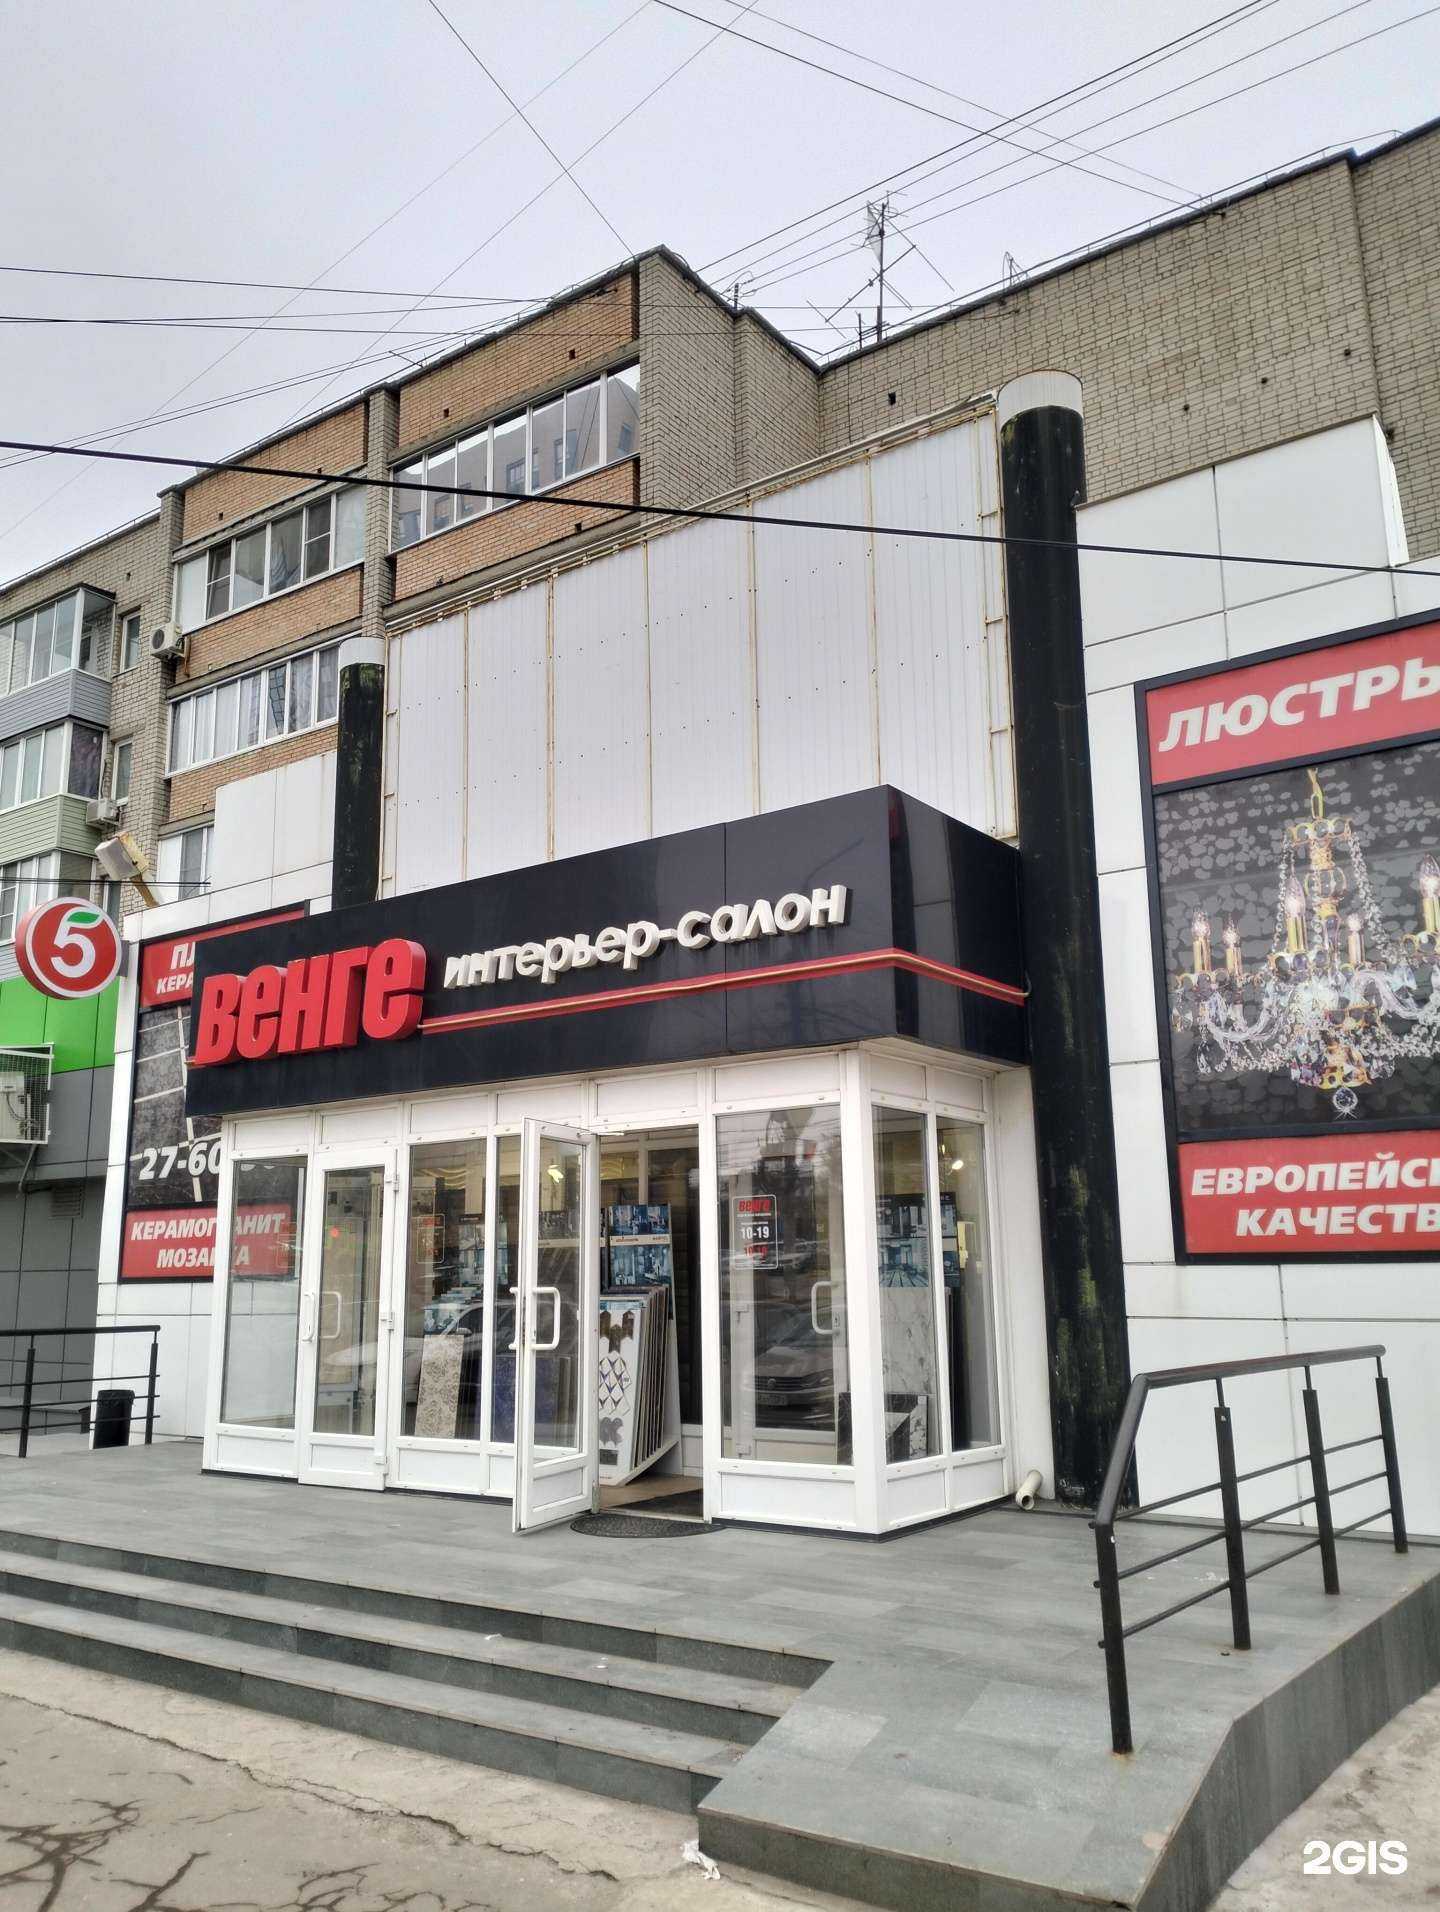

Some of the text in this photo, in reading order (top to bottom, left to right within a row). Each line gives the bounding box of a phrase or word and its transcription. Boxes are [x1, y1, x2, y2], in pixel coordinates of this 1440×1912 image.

[51, 908, 102, 978] 5
[444, 884, 848, 989] интерьер-салон
[130, 1213, 286, 1241] КЕРАМОГАНИТ
[741, 1226, 770, 1240] 10-19
[156, 1245, 250, 1269] МОЗАА
